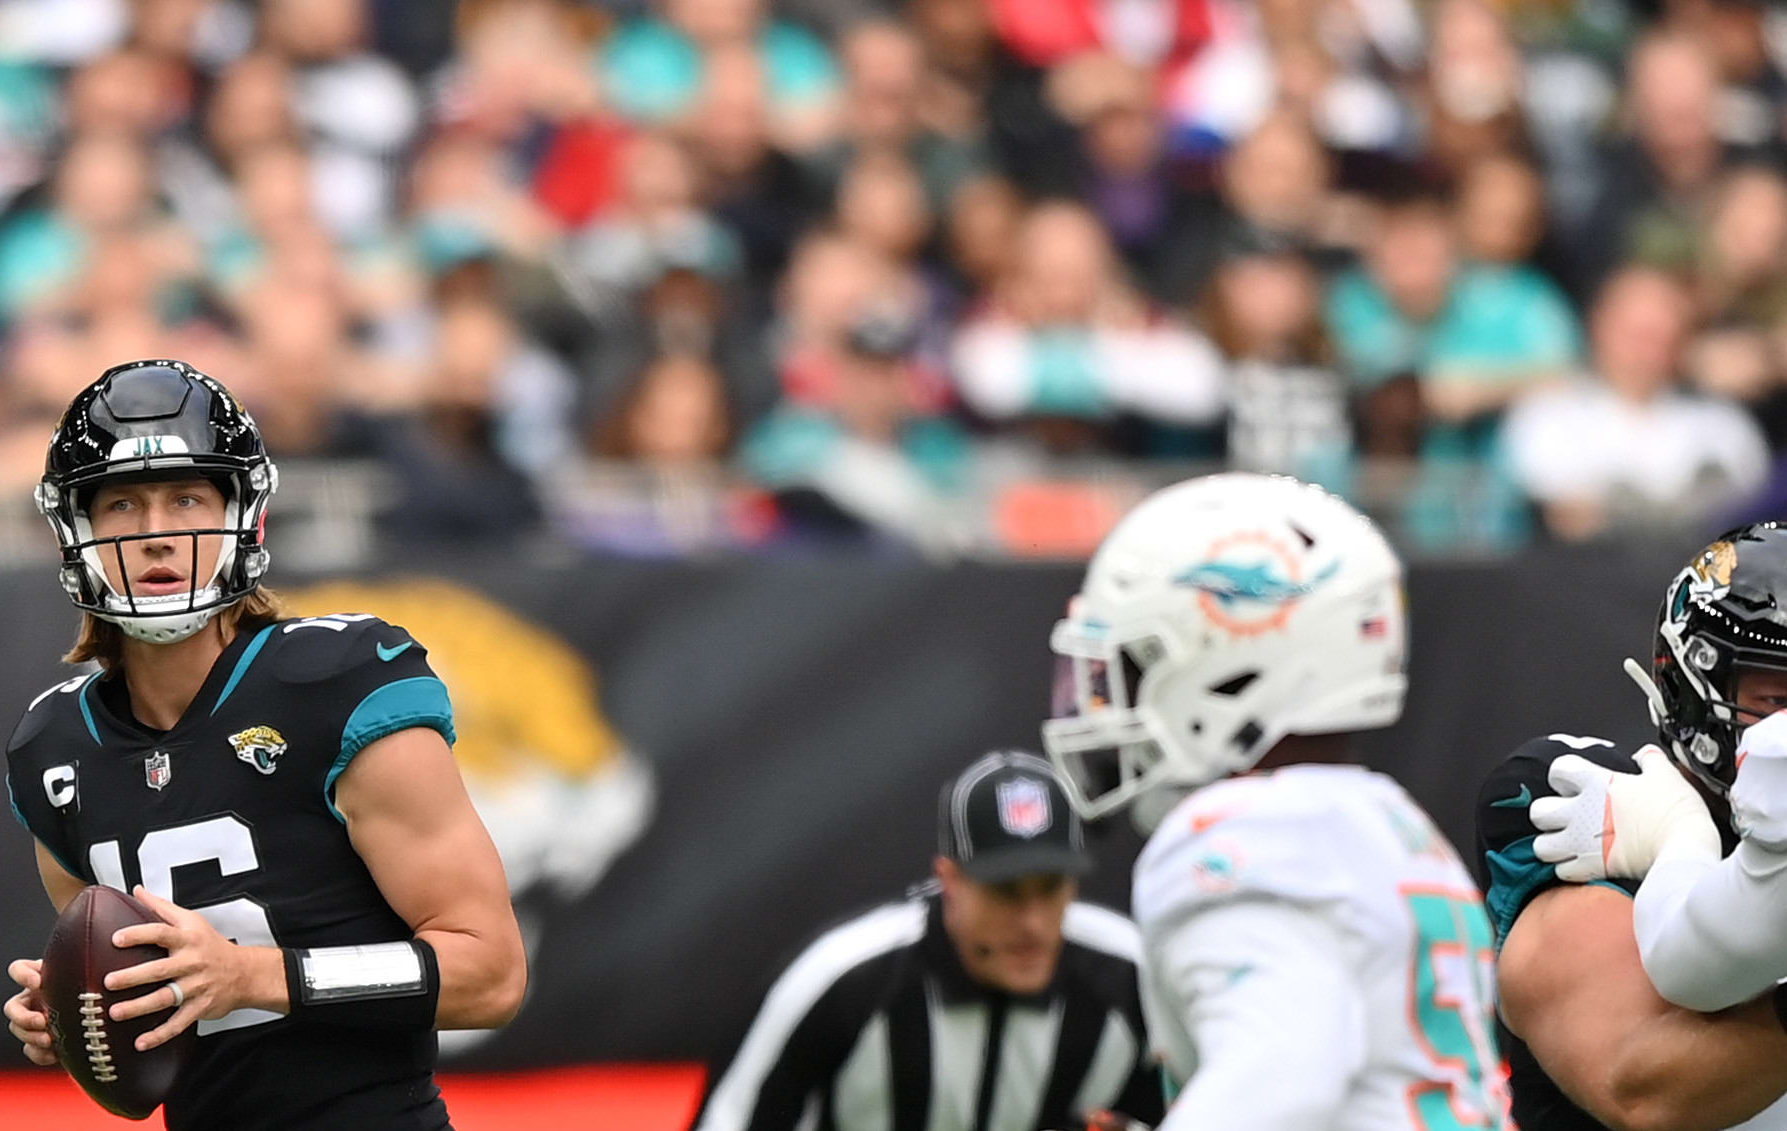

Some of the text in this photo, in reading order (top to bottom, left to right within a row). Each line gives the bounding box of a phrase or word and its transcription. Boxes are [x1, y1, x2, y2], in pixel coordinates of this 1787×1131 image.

[133, 435, 165, 456] JAX
[43, 765, 75, 808] C
[89, 815, 286, 1037] 6
